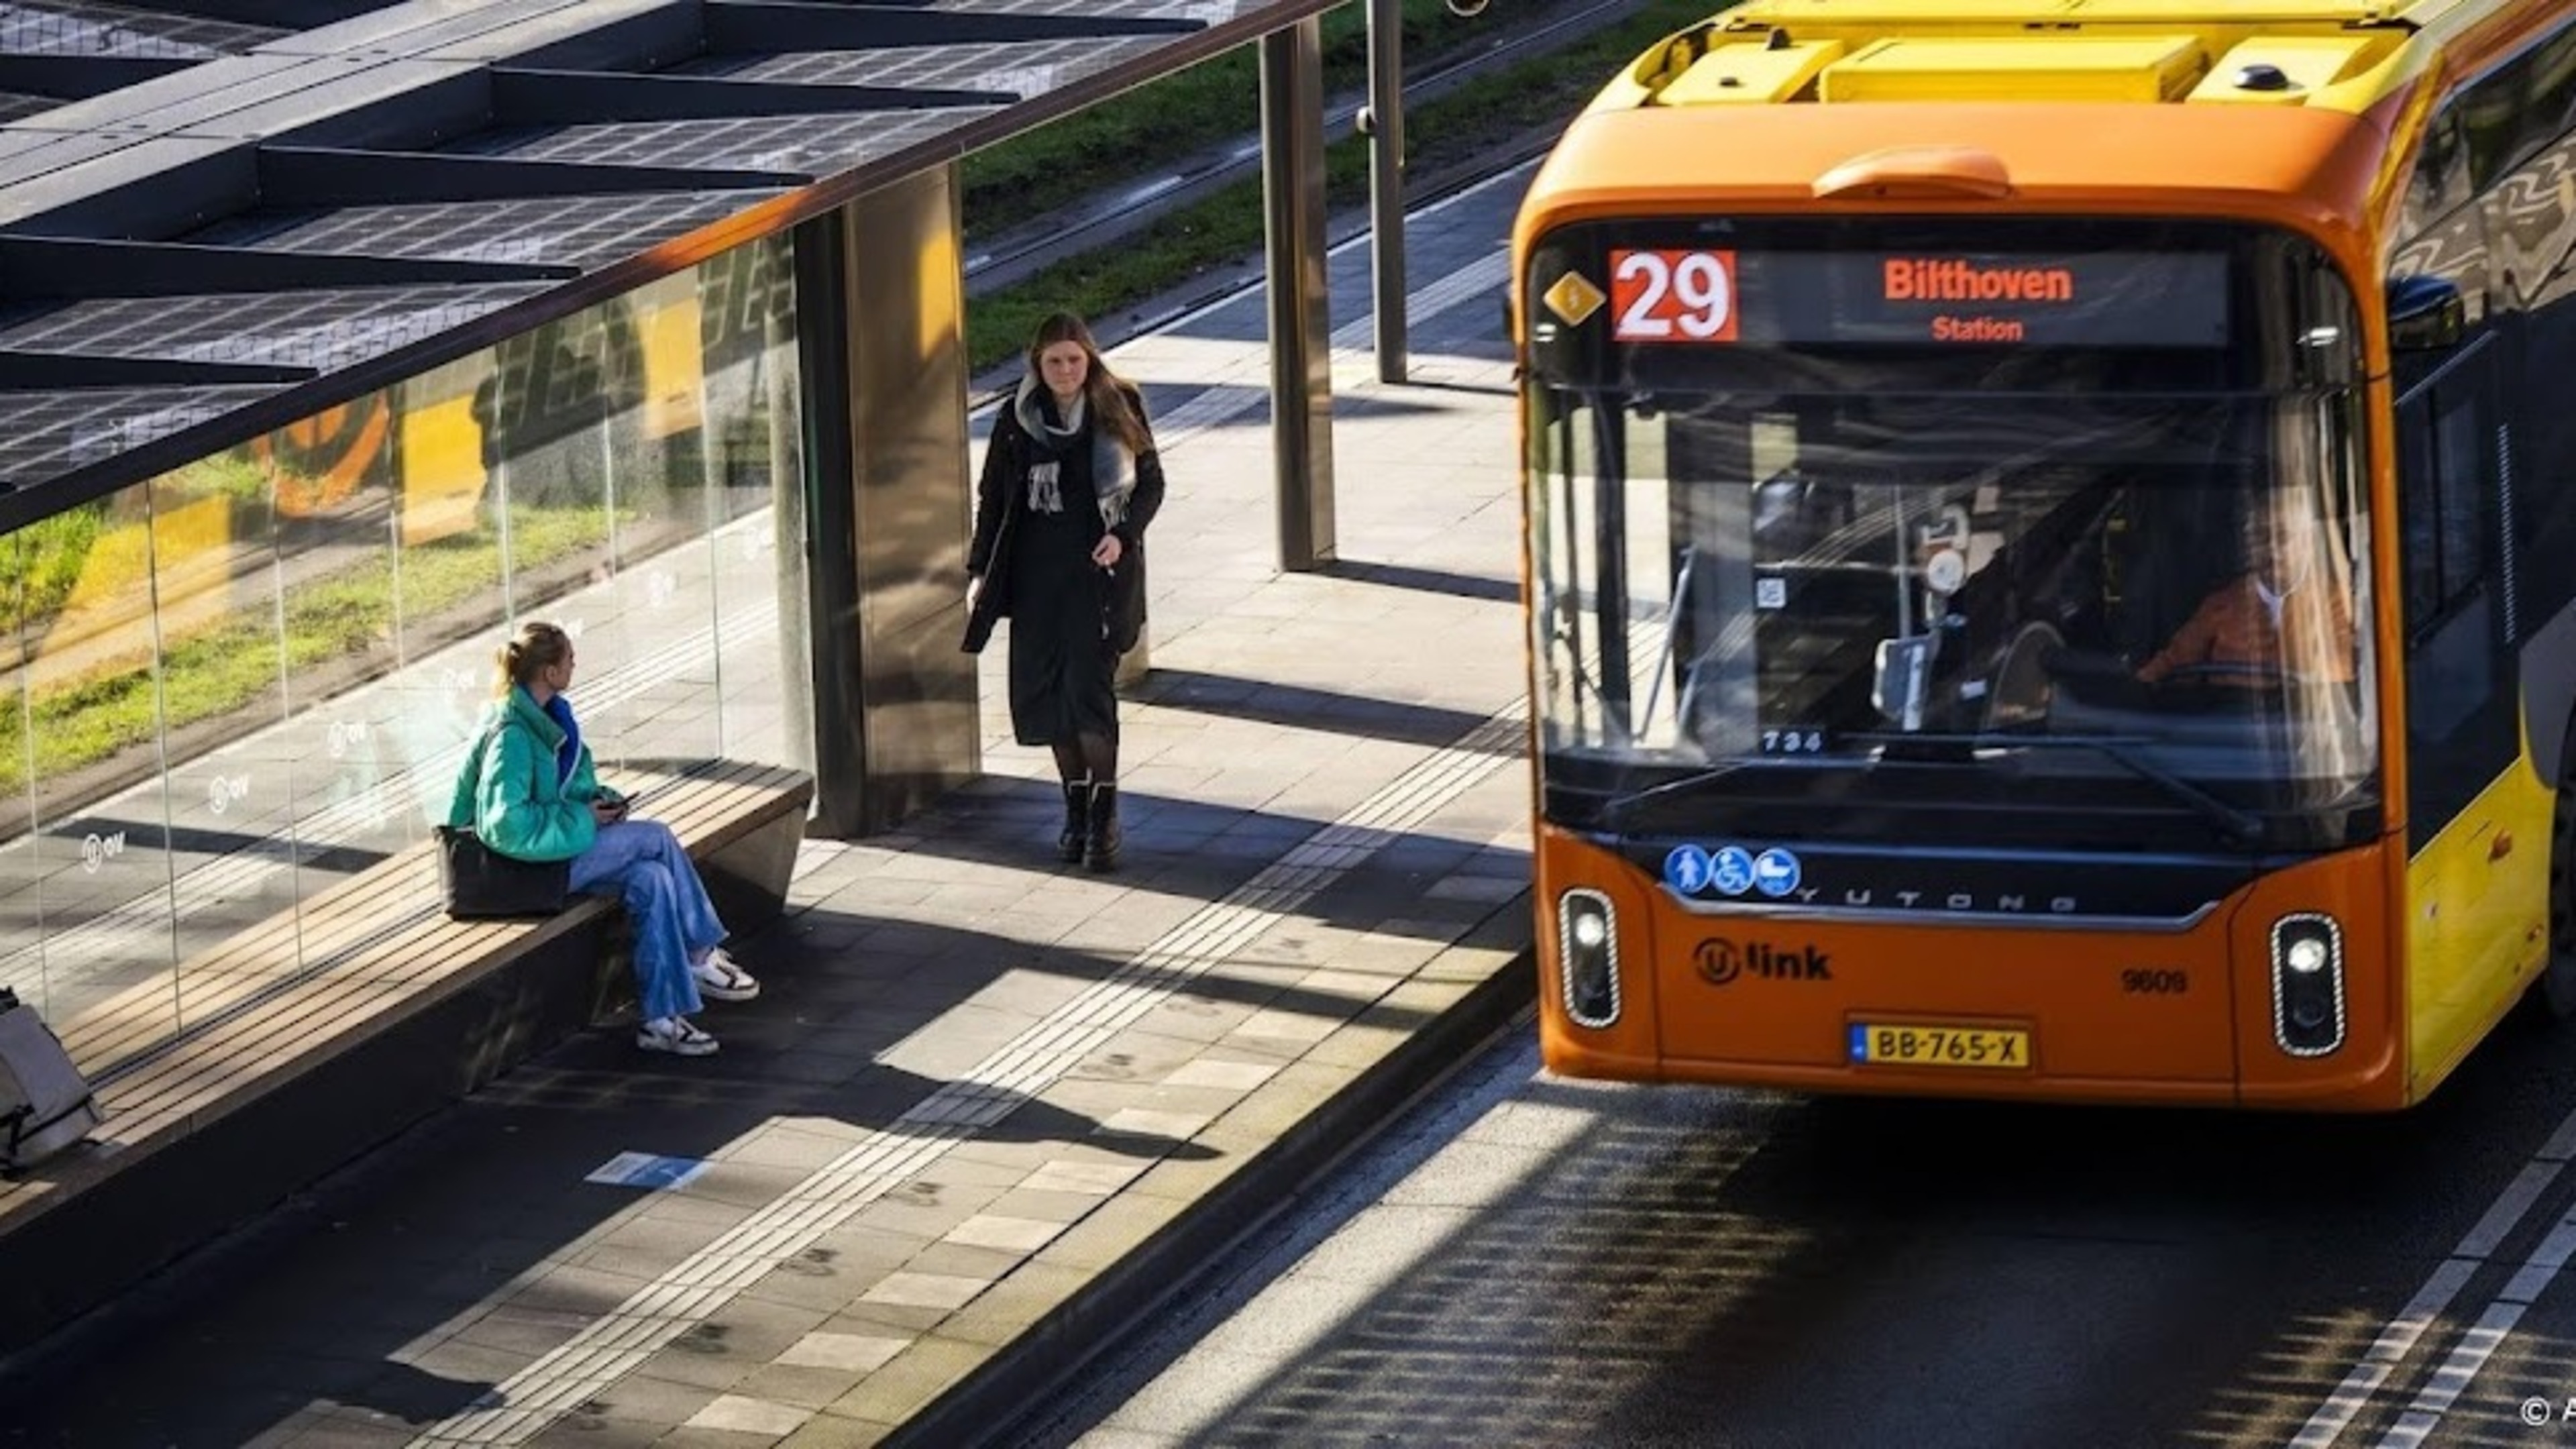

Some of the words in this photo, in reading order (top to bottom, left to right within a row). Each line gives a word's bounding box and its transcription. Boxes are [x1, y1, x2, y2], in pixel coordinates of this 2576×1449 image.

[1616, 254, 1731, 337] 29
[1885, 260, 2072, 300] Bilthoven
[1933, 316, 2023, 341] Station
[1796, 888, 2076, 912] YUTONG
[1878, 1030, 2017, 1062] BB-765-X
